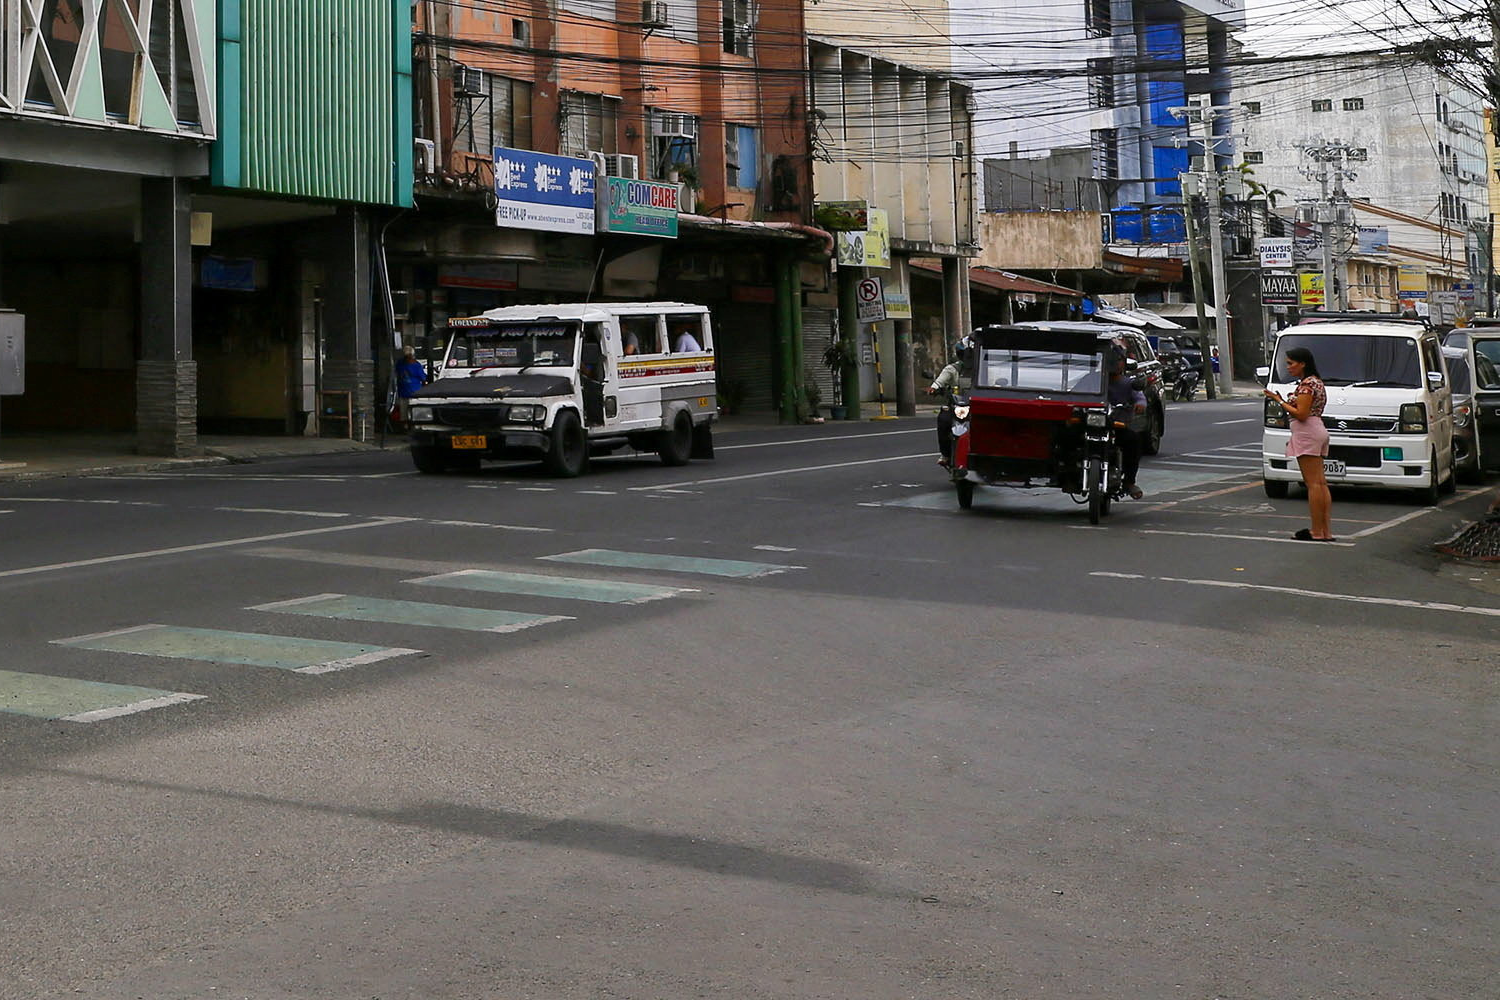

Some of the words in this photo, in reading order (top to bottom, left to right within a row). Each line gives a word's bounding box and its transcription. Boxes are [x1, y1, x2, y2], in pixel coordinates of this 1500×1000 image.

[627, 182, 677, 209] COMCARE
[509, 206, 527, 221] PICK-UP
[635, 215, 650, 225] HEAD
[650, 217, 668, 228] OFFICE
[1260, 245, 1291, 253] DIALYSIS
[1262, 278, 1297, 293] MAYAA
